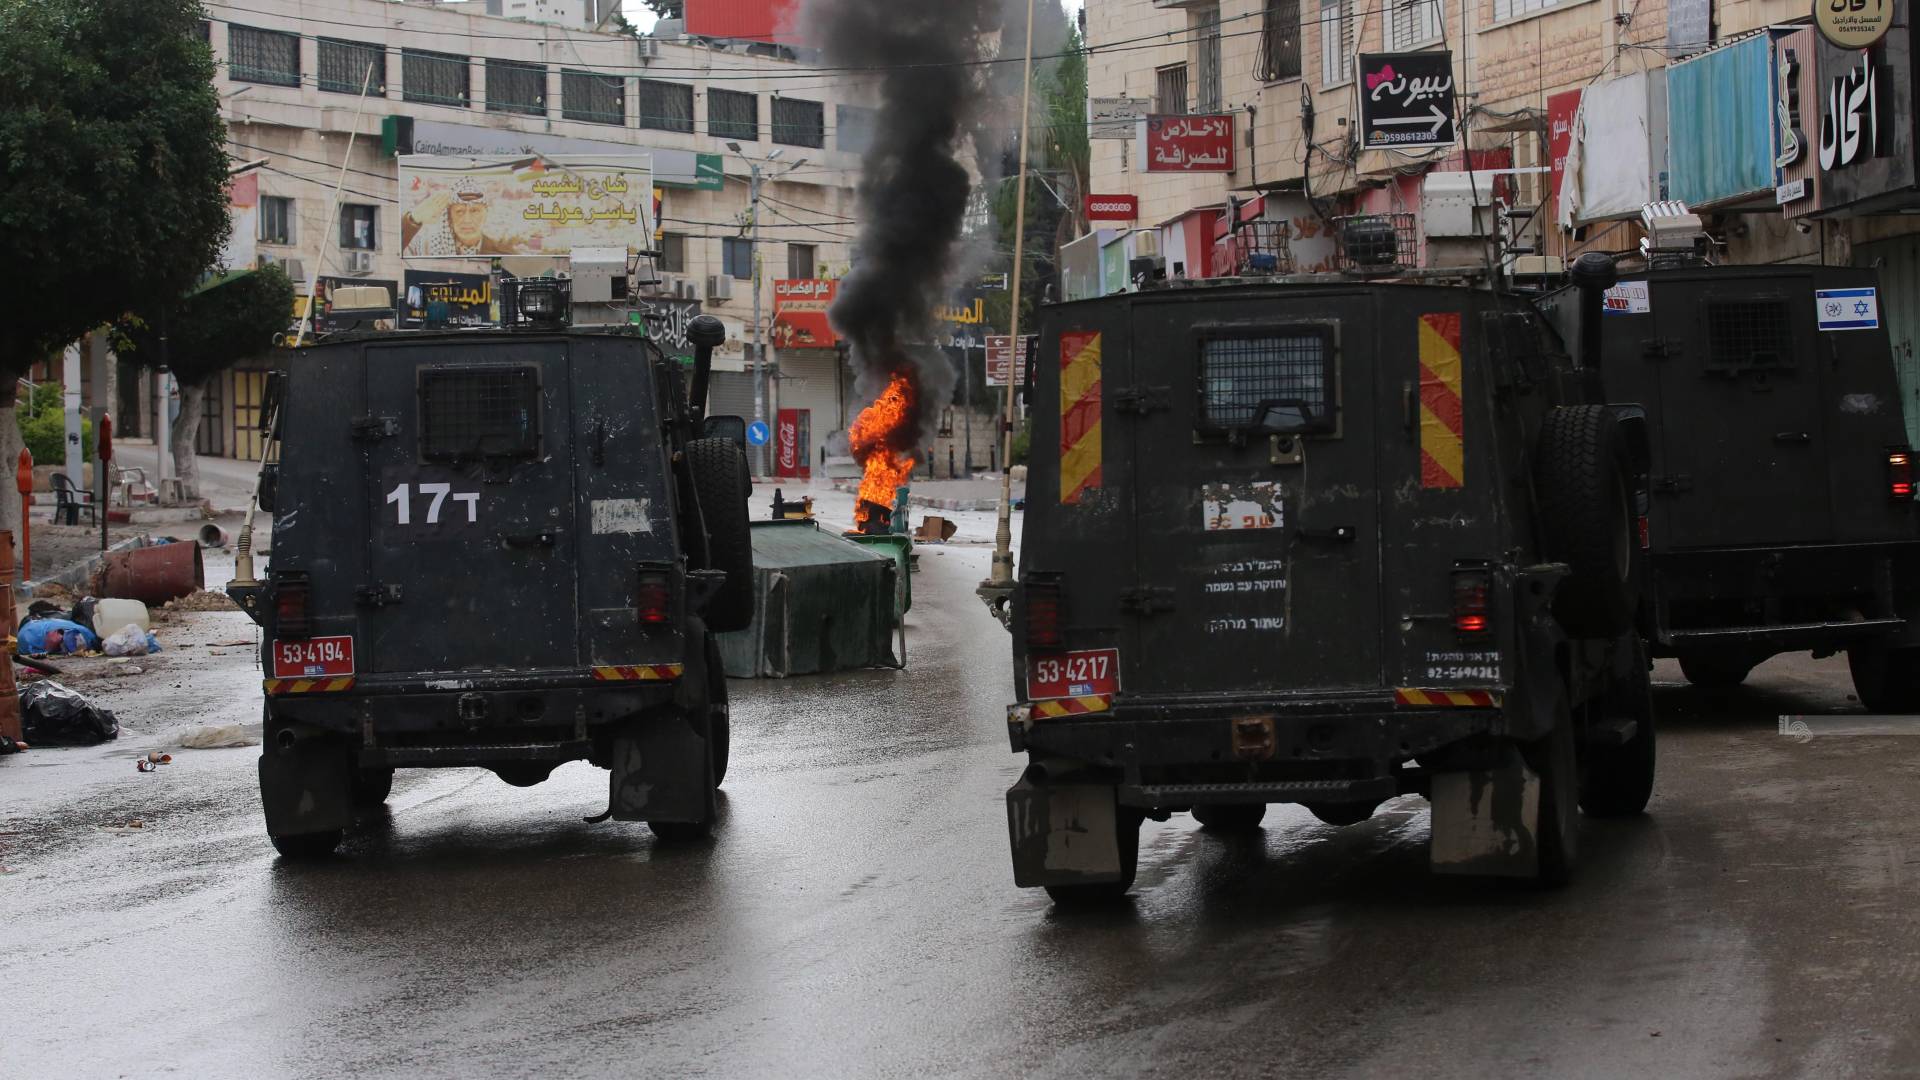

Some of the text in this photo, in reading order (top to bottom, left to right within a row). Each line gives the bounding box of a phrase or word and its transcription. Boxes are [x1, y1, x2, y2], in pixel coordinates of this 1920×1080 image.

[1384, 131, 1438, 143] 0598612305
[1155, 144, 1228, 169] للصرافة
[532, 173, 629, 199] شارع الشهيد
[523, 202, 638, 225] ياسر عرفات
[1090, 202, 1132, 212] ooredoo
[813, 281, 830, 299] عالم
[1205, 582, 1235, 593] נשמה
